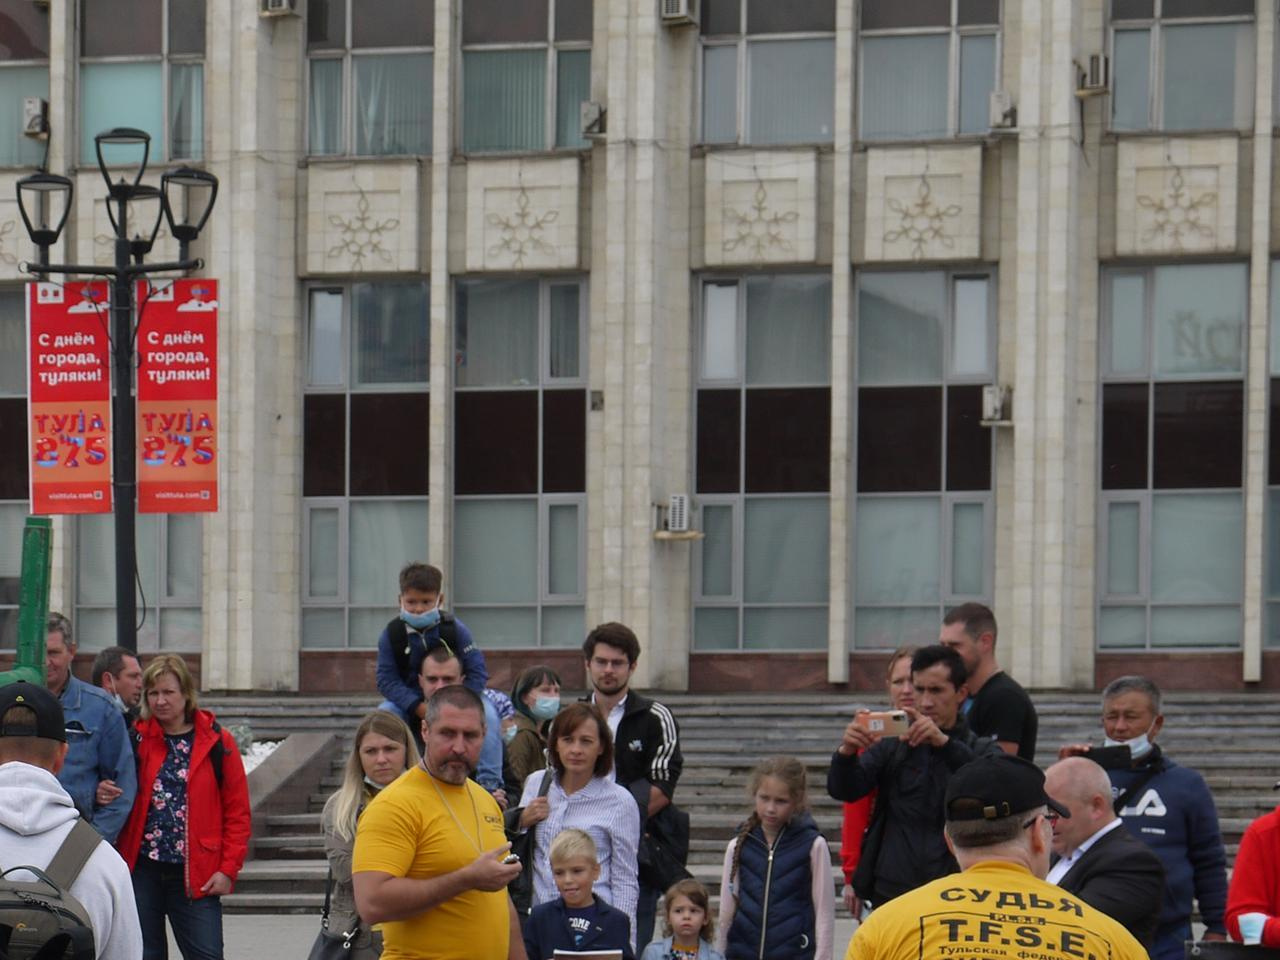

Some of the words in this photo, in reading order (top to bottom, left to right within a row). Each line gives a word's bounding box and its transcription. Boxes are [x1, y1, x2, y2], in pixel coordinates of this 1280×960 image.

[39, 333, 50, 347] С
[54, 332, 95, 348] днём
[147, 331, 159, 345] С
[163, 330, 204, 346] днём
[39, 353, 101, 368] города,
[147, 351, 210, 366] города,
[39, 368, 102, 386] туляки!
[147, 367, 211, 385] туляки!
[34, 409, 106, 435] ТУЛА
[142, 408, 214, 434] ТУЛА
[35, 434, 106, 468] 875
[142, 433, 215, 467] 875
[939, 887, 1084, 918] СУДЬЯ
[938, 945, 1008, 956] Тульская
